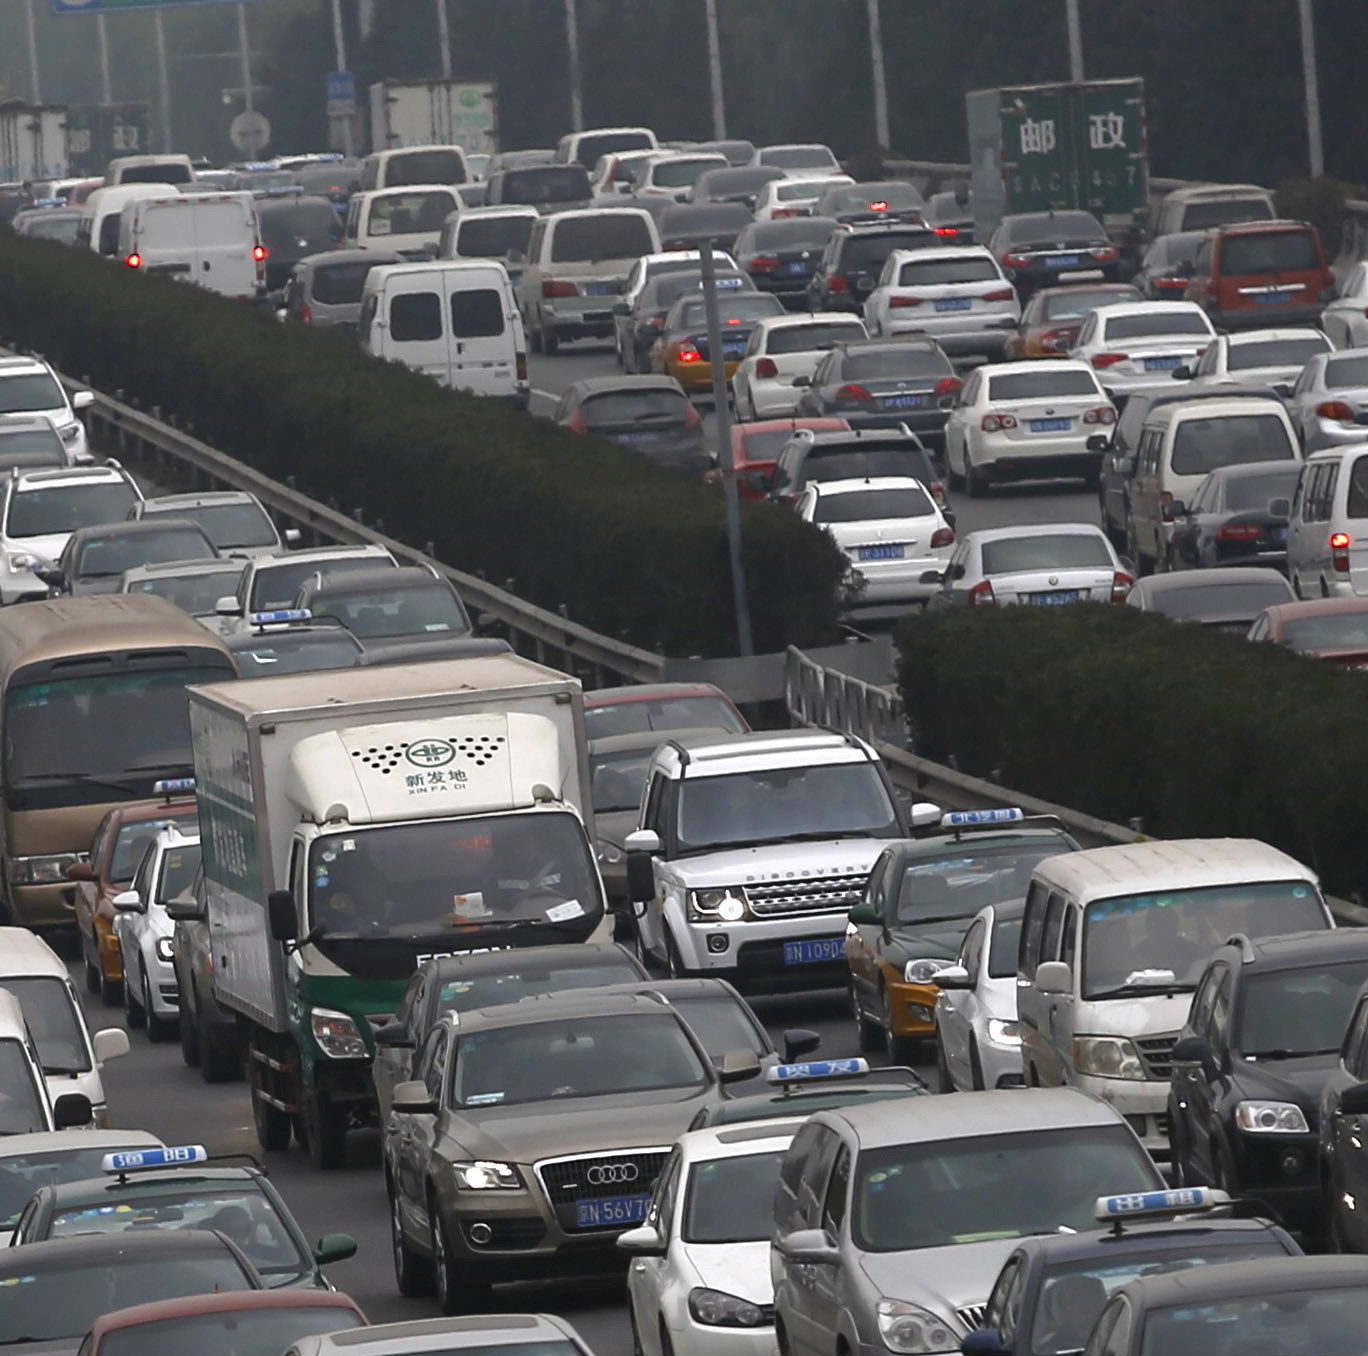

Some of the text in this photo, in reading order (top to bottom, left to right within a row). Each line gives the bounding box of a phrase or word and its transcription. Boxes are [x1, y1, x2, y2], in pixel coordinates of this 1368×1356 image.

[1020, 112, 1127, 155] 邮政
[406, 769, 469, 788] 新发地
